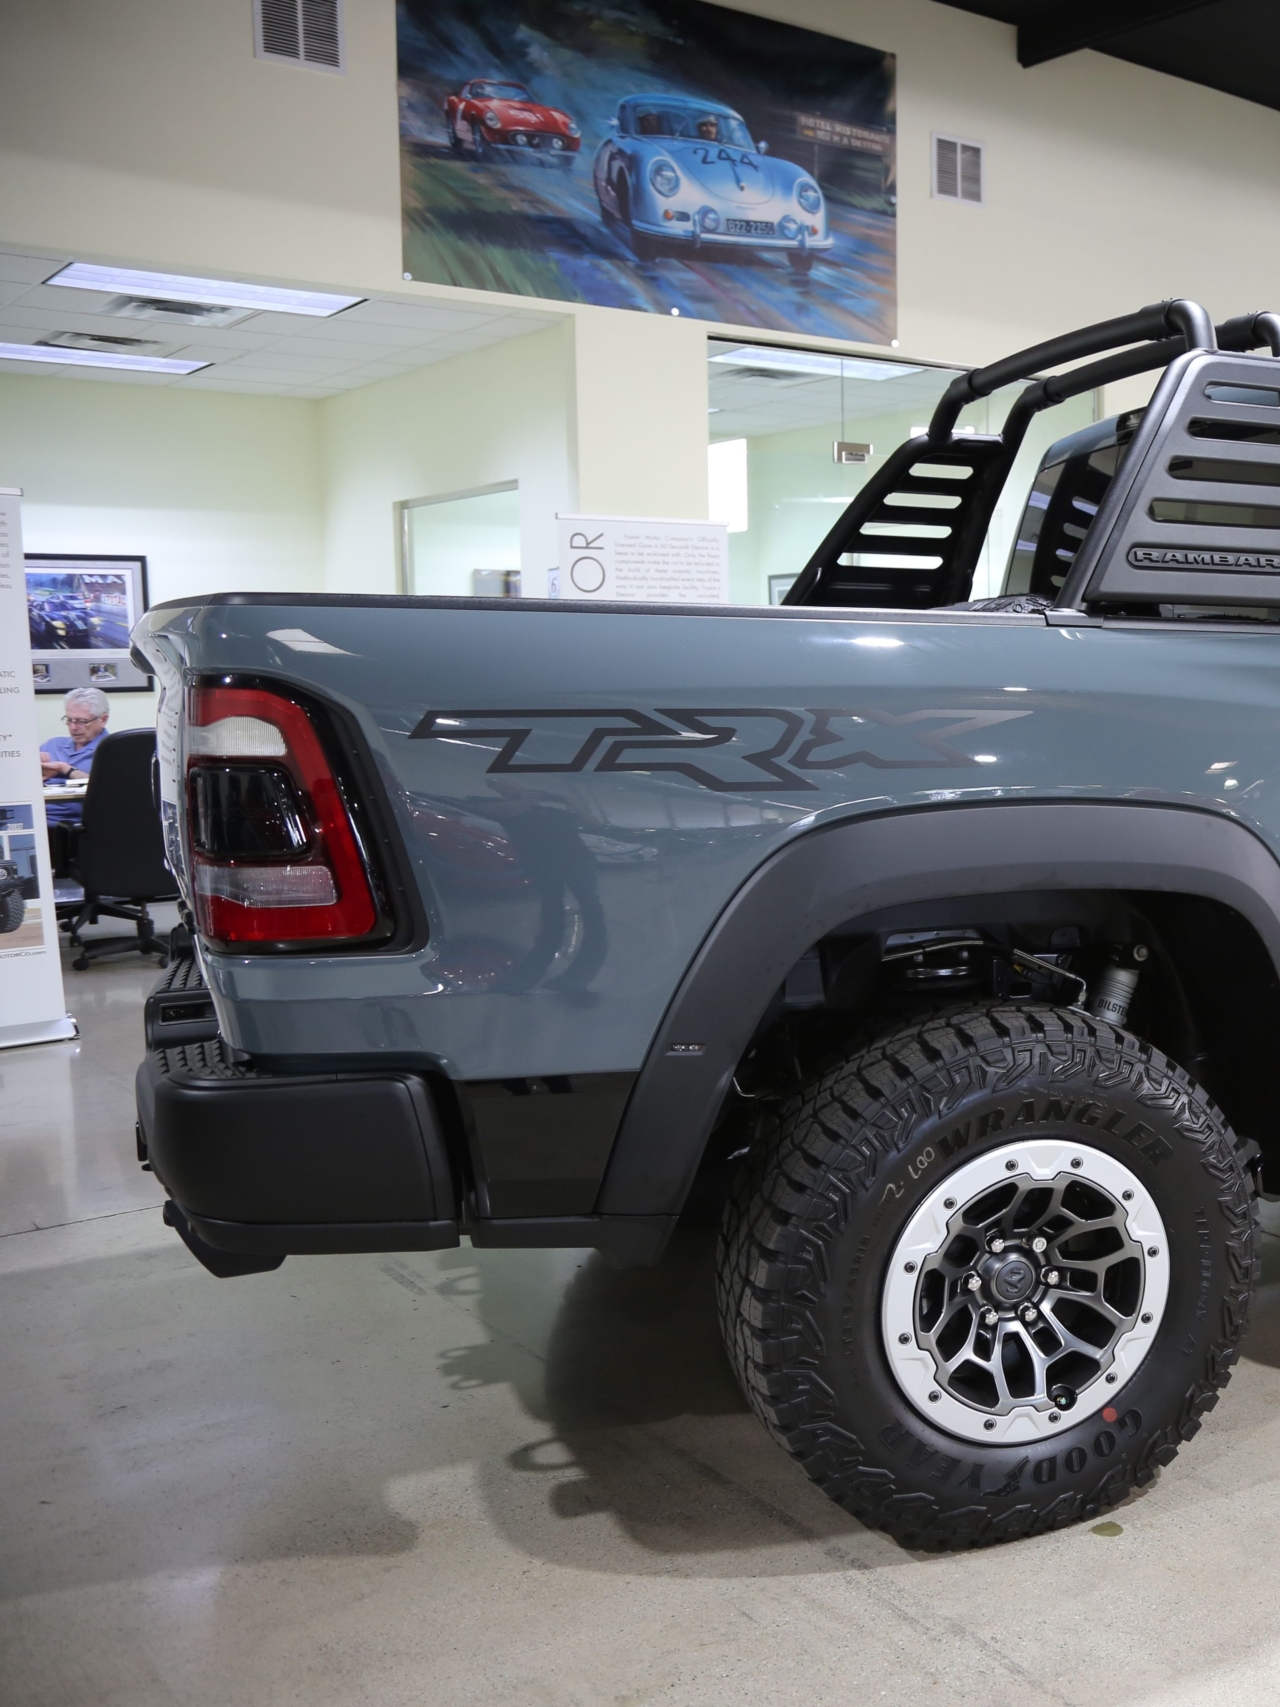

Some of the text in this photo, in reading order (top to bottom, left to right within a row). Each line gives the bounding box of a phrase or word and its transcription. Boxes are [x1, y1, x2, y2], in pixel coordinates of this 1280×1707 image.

[693, 147, 759, 172] 244
[1133, 550, 1280, 569] RAMBAR
[406, 707, 1034, 792] TRX
[935, 1098, 1173, 1167] WRANGLER
[879, 1408, 1143, 1497] GOODYEAR
